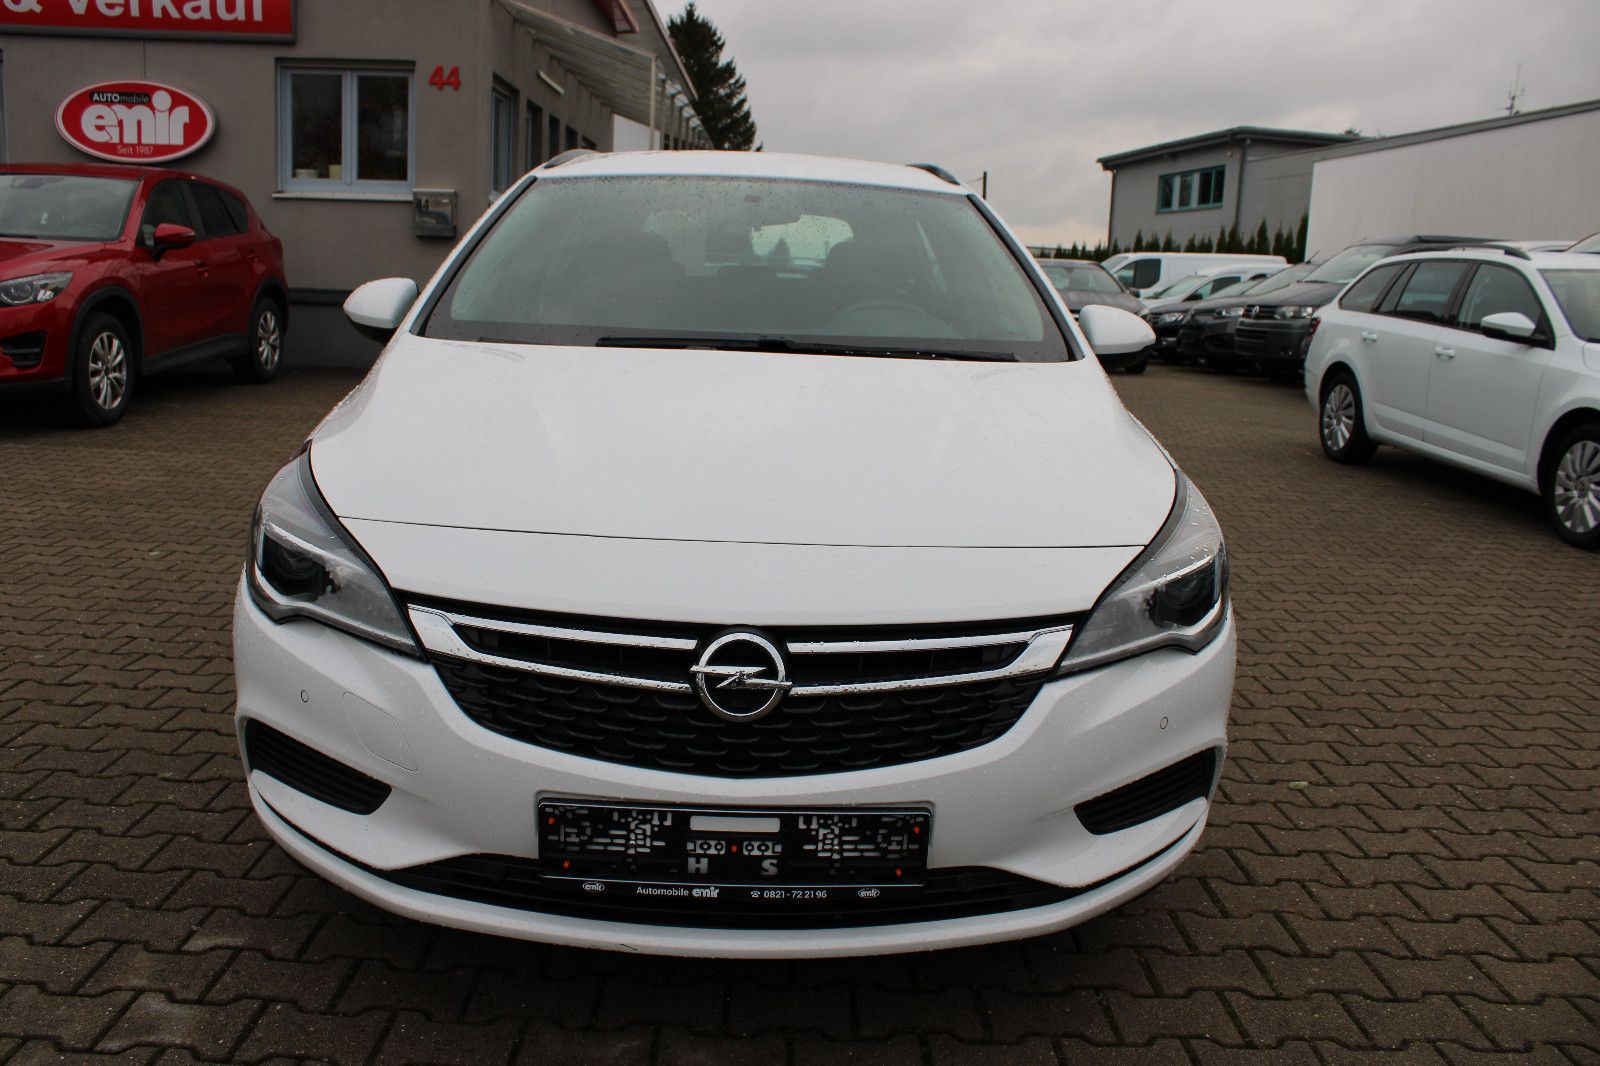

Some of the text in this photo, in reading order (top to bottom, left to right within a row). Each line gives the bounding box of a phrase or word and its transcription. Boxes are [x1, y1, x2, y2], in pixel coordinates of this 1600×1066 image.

[429, 64, 462, 90] 44
[92, 93, 149, 103] AUTOmobile
[81, 90, 190, 145] emir
[117, 145, 154, 155] Seit 1987
[636, 886, 719, 898] Automobile emir
